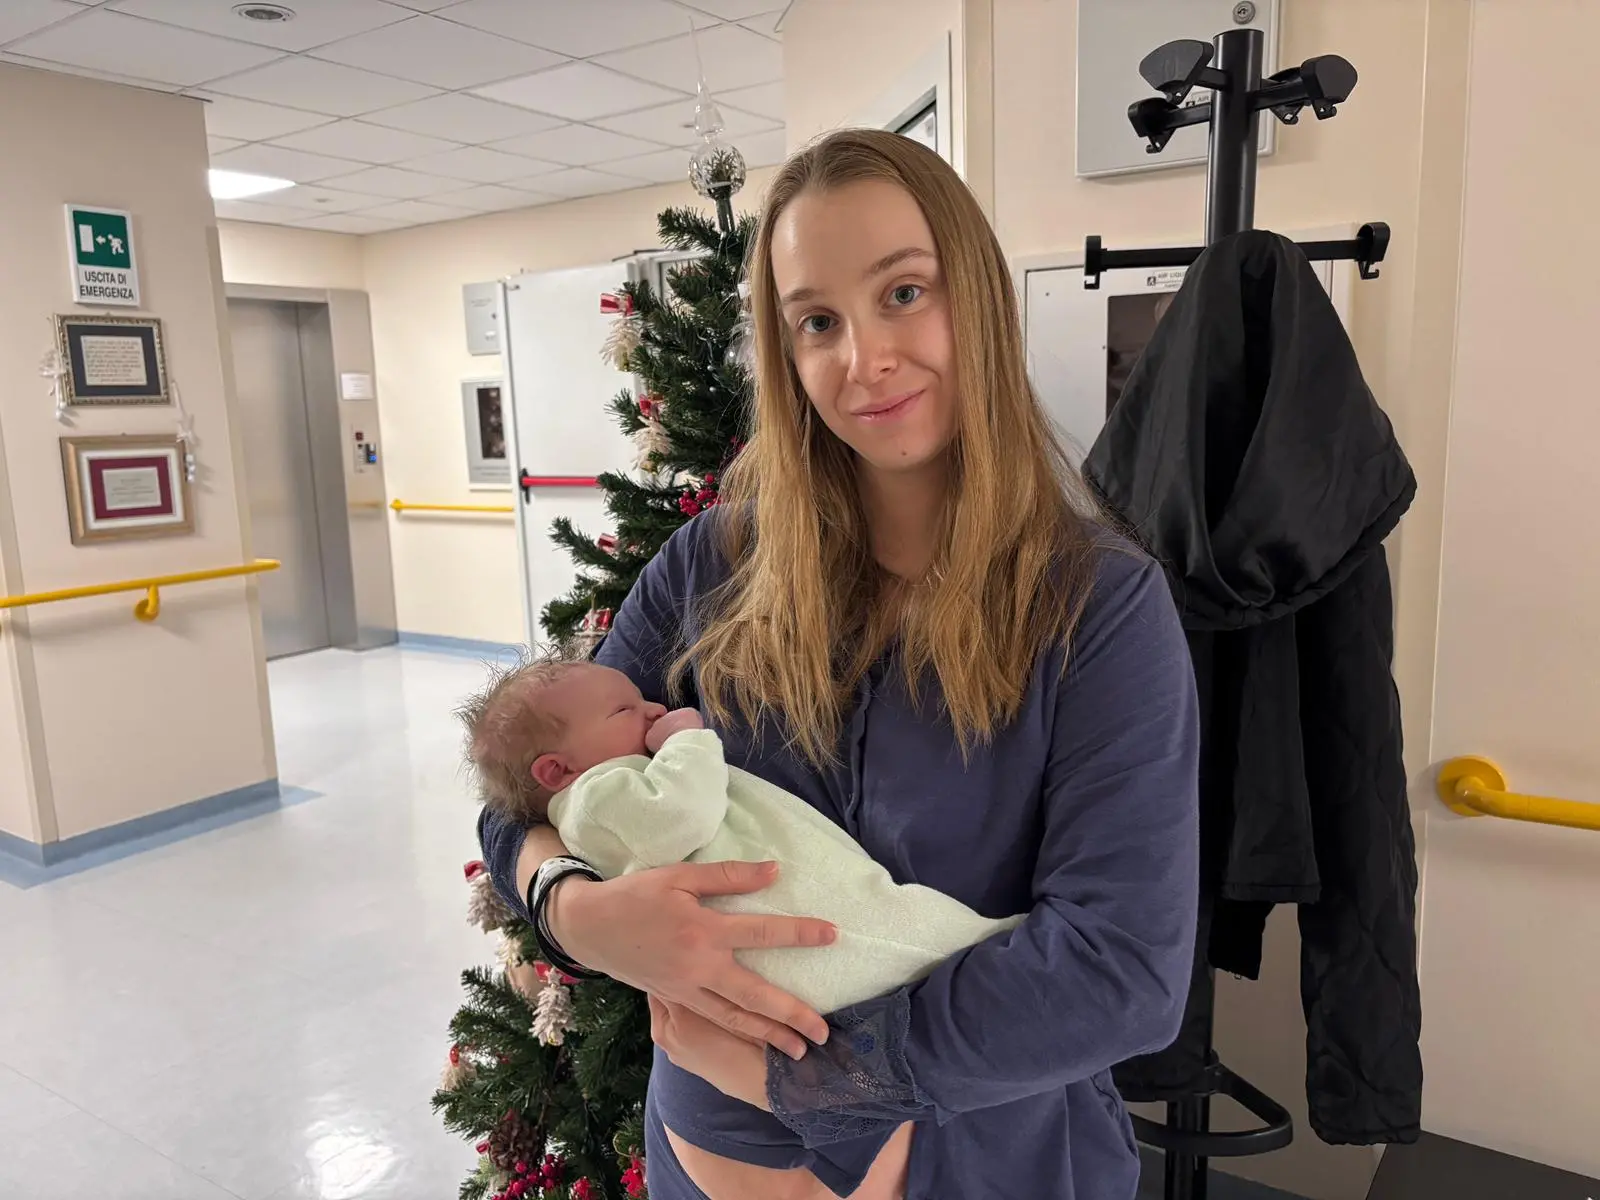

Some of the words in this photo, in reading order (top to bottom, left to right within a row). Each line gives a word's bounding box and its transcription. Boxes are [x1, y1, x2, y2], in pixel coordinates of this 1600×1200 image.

[84, 270, 116, 284] USCITA
[117, 272, 127, 285] DI
[80, 284, 134, 300] EMERGENZA
